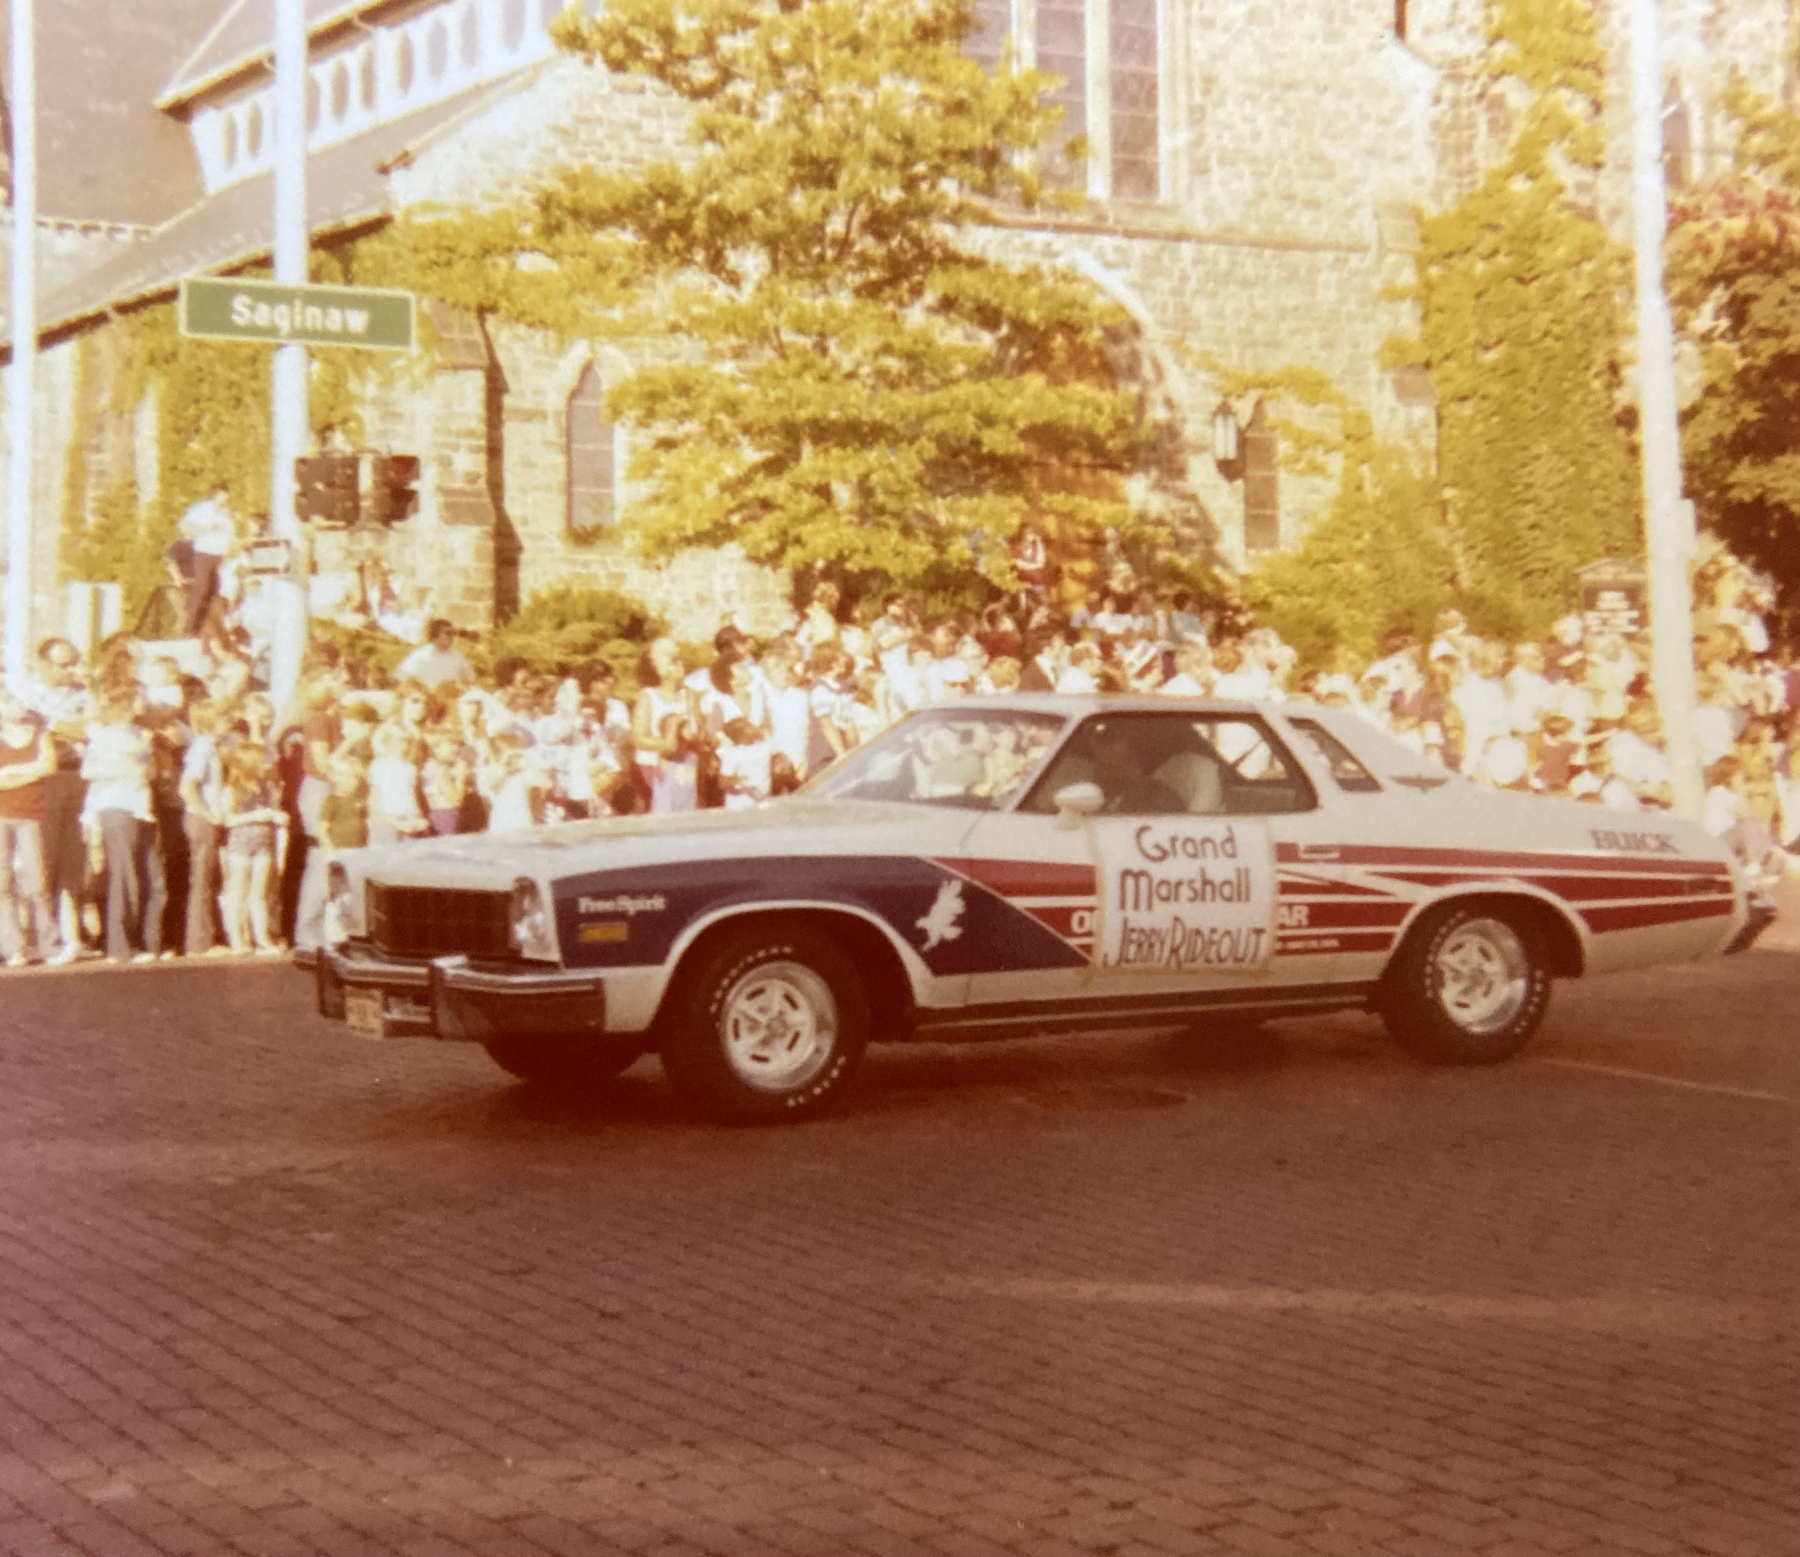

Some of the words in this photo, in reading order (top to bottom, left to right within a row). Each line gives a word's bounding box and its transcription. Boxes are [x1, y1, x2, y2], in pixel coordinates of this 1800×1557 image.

[231, 293, 368, 337] Saginaw
[1136, 825, 1238, 862] Grand
[1590, 829, 1680, 854] BUICK
[1119, 867, 1252, 911] Marshall
[1164, 916, 1266, 969] RIDEOUT
